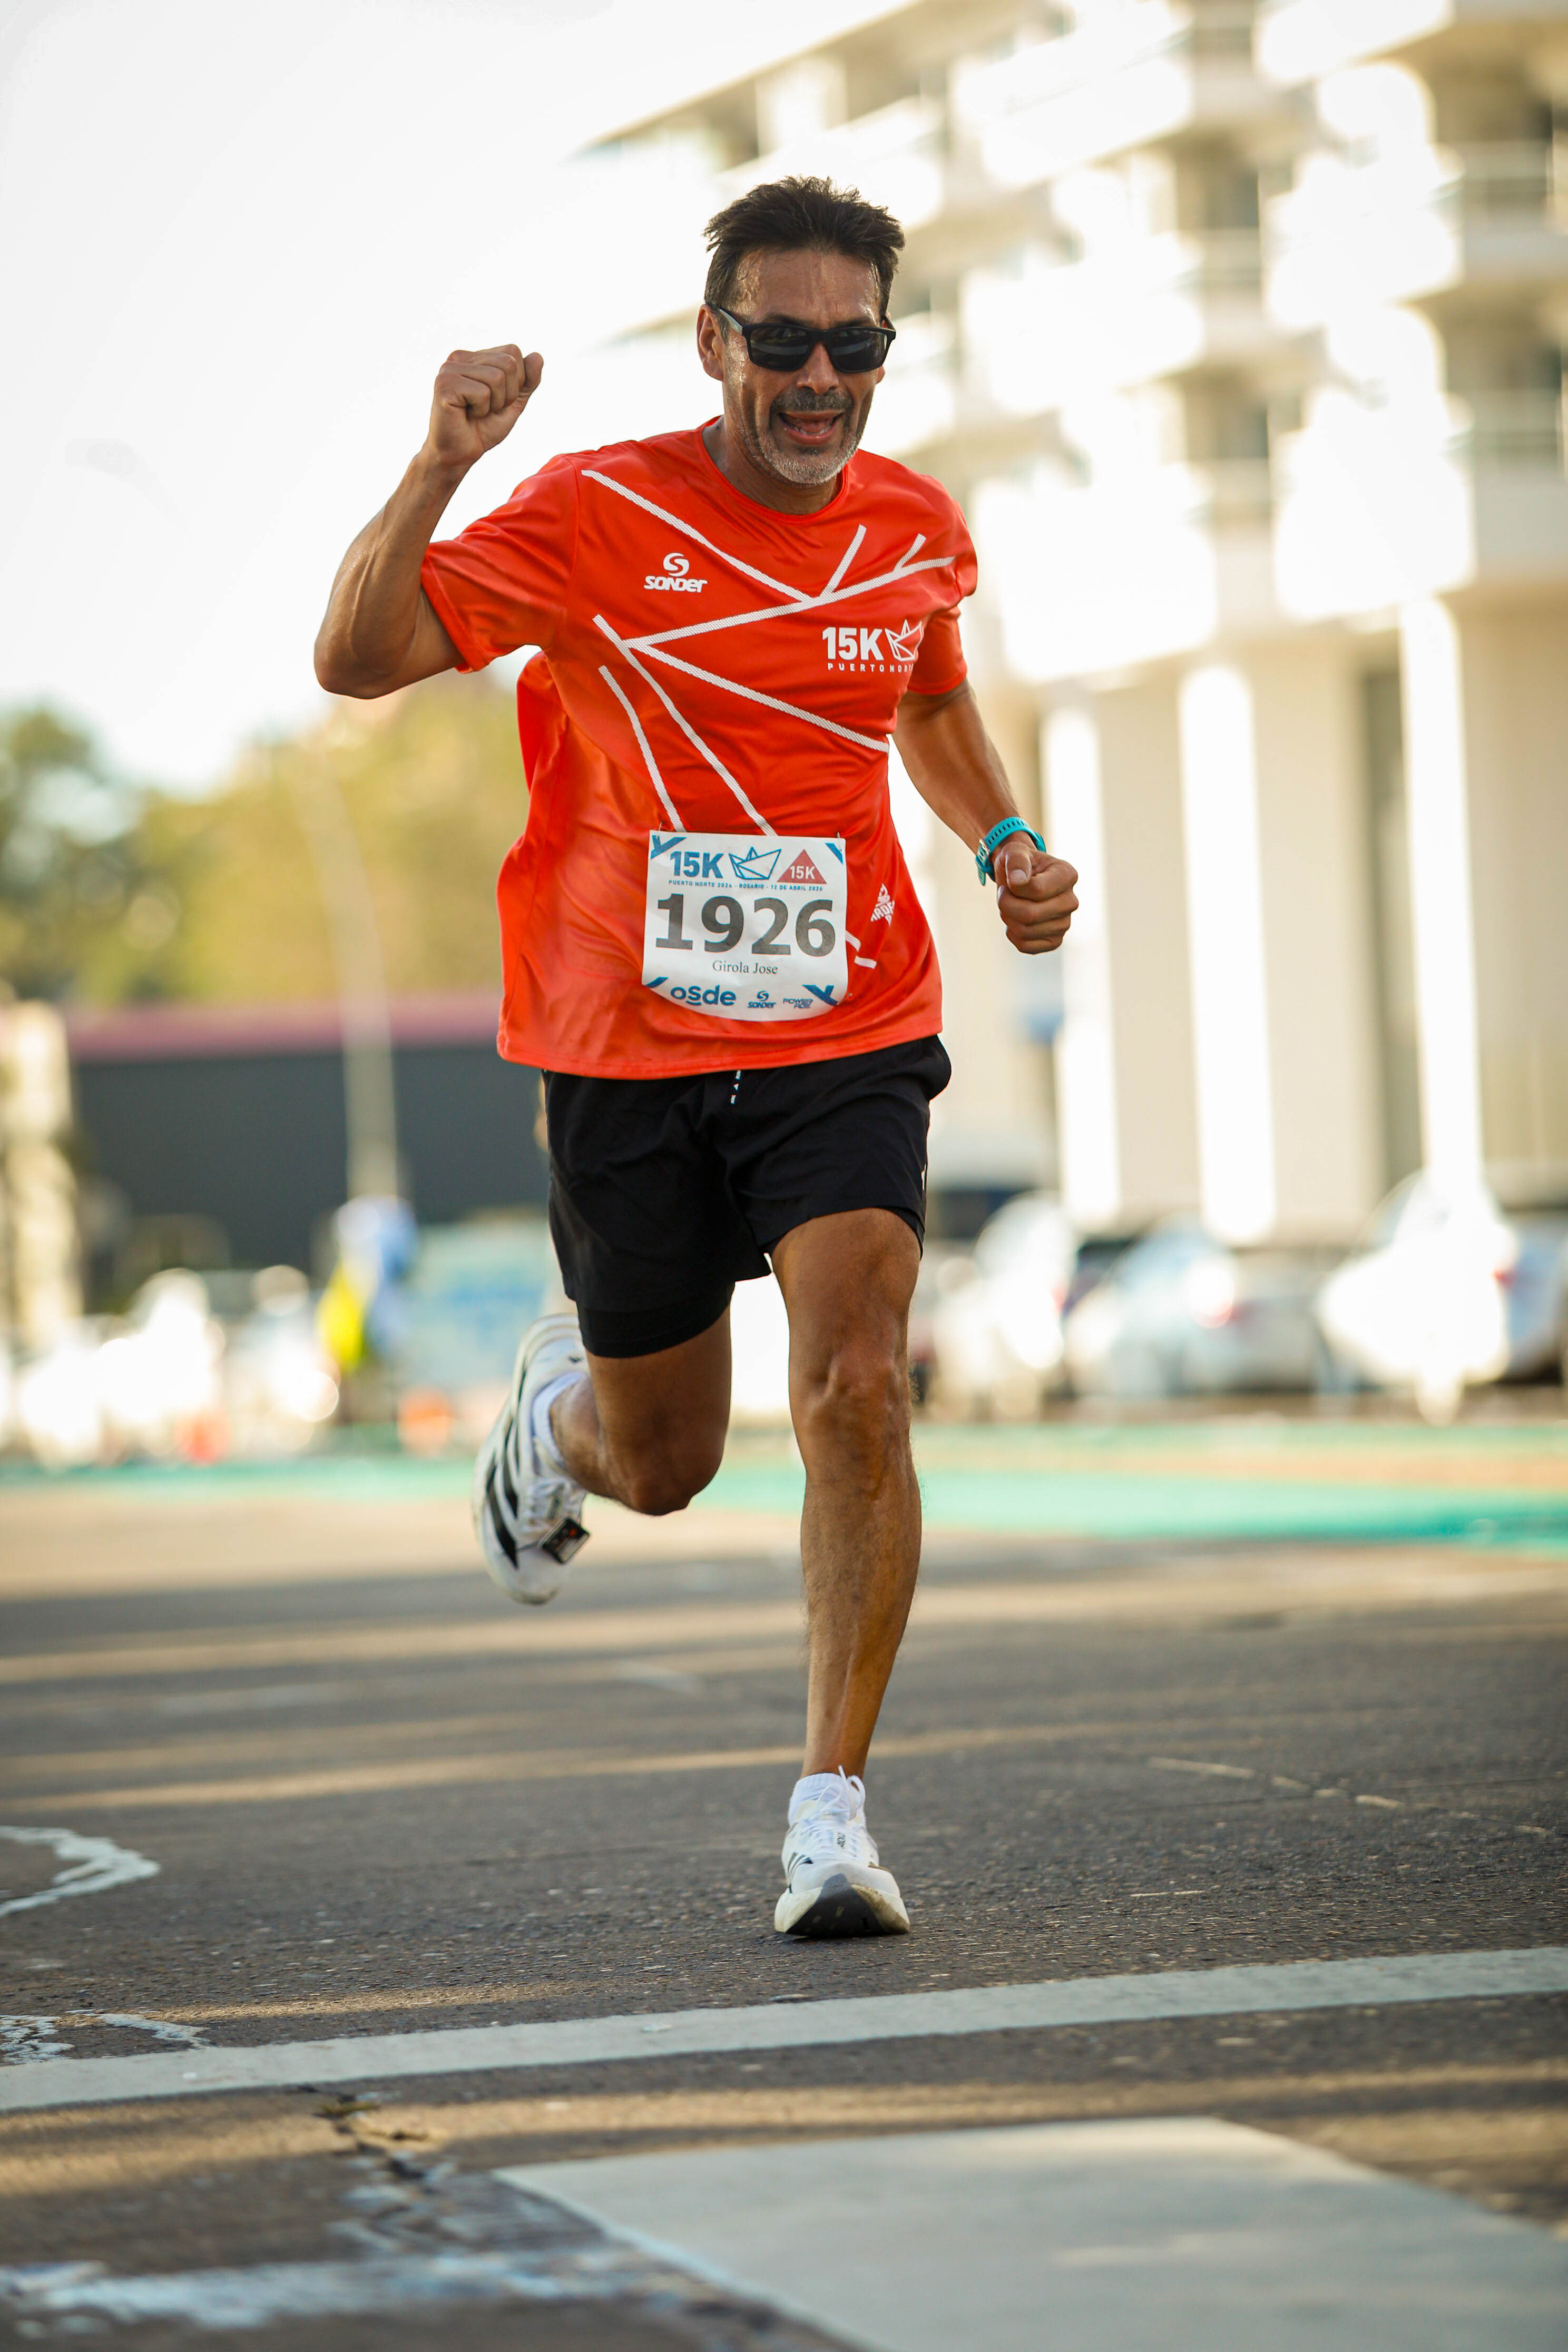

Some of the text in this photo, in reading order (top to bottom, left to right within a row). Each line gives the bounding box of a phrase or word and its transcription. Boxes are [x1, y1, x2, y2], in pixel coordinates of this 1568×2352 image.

[822, 628, 884, 661] 15K
[827, 662, 885, 672] PUERTO
[670, 851, 724, 879] 15K
[790, 866, 815, 879] 15K
[655, 893, 836, 957] 1926
[712, 960, 778, 974] Girola Jose
[670, 984, 737, 1006] osde
